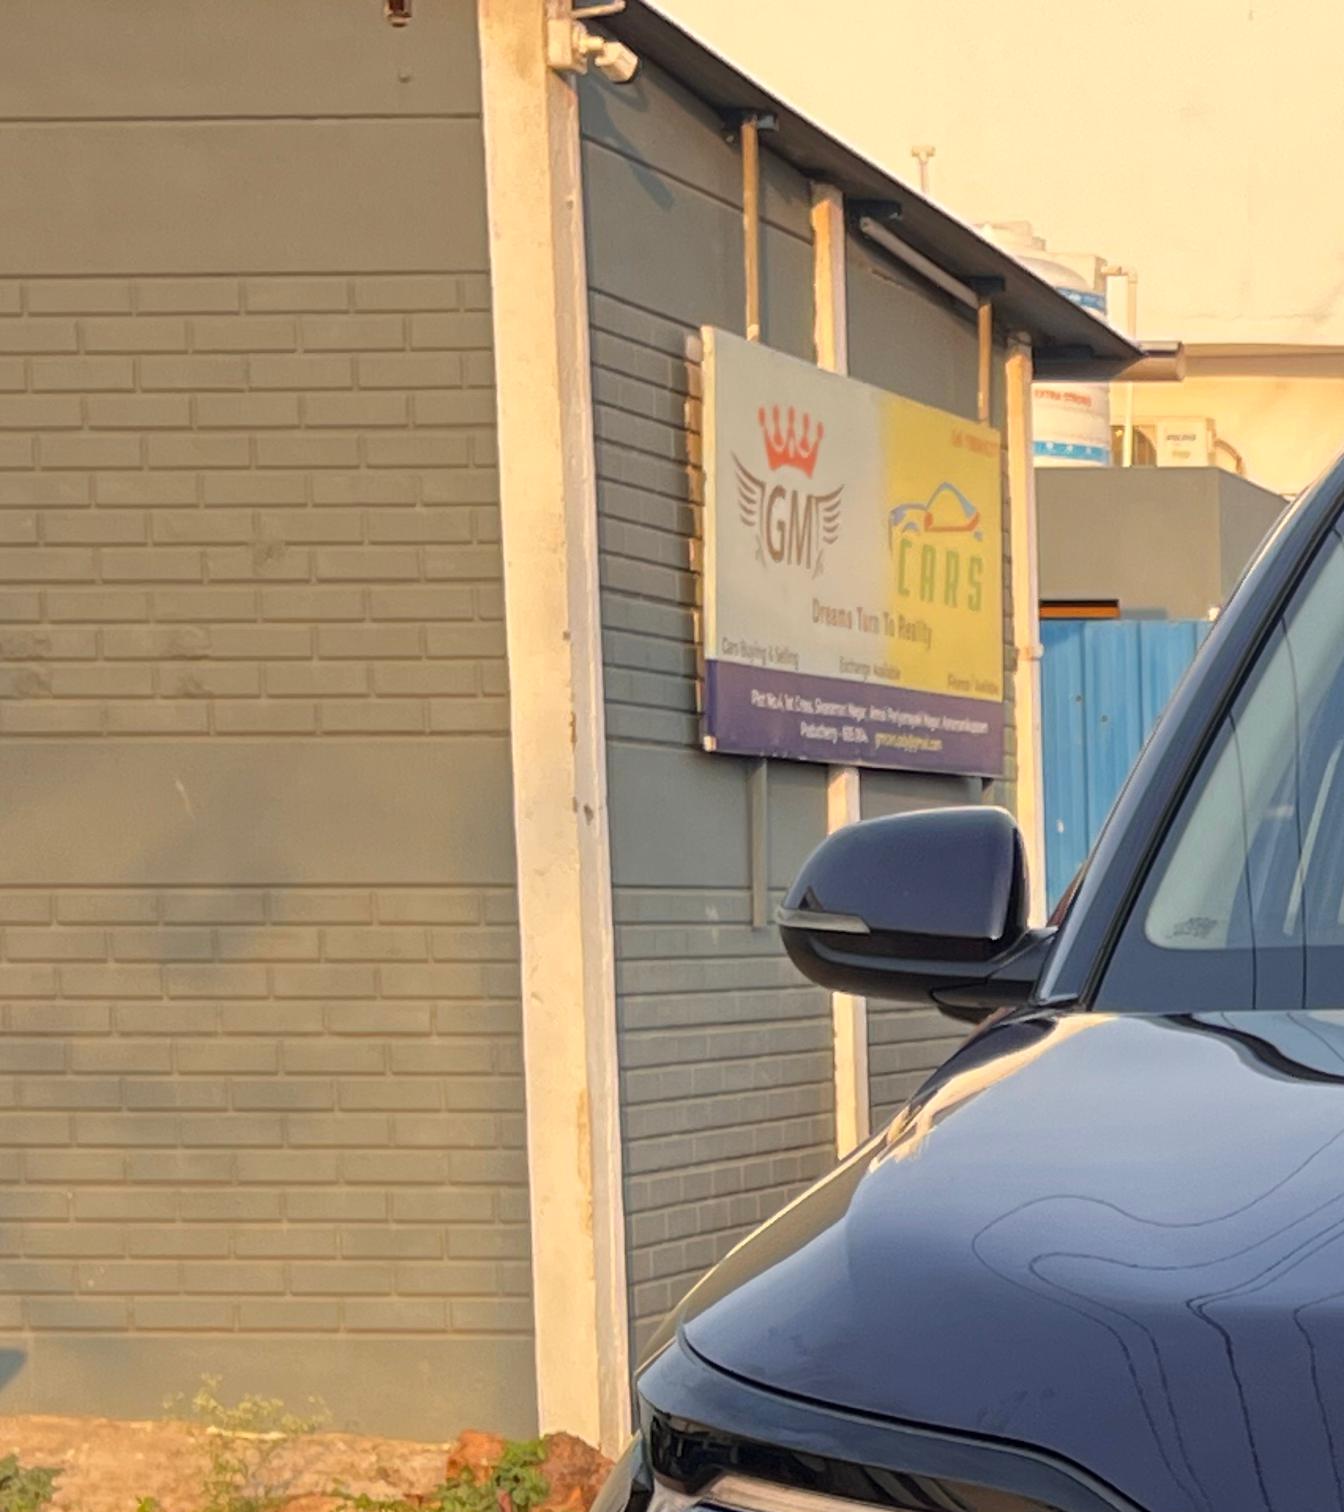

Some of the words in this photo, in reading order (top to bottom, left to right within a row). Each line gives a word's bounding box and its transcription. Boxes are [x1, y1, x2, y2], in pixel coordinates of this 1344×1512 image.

[766, 485, 812, 570] GM
[897, 537, 984, 612] CARS
[811, 597, 852, 630] Dreams
[856, 606, 880, 634] Turn
[898, 614, 933, 652] Reality
